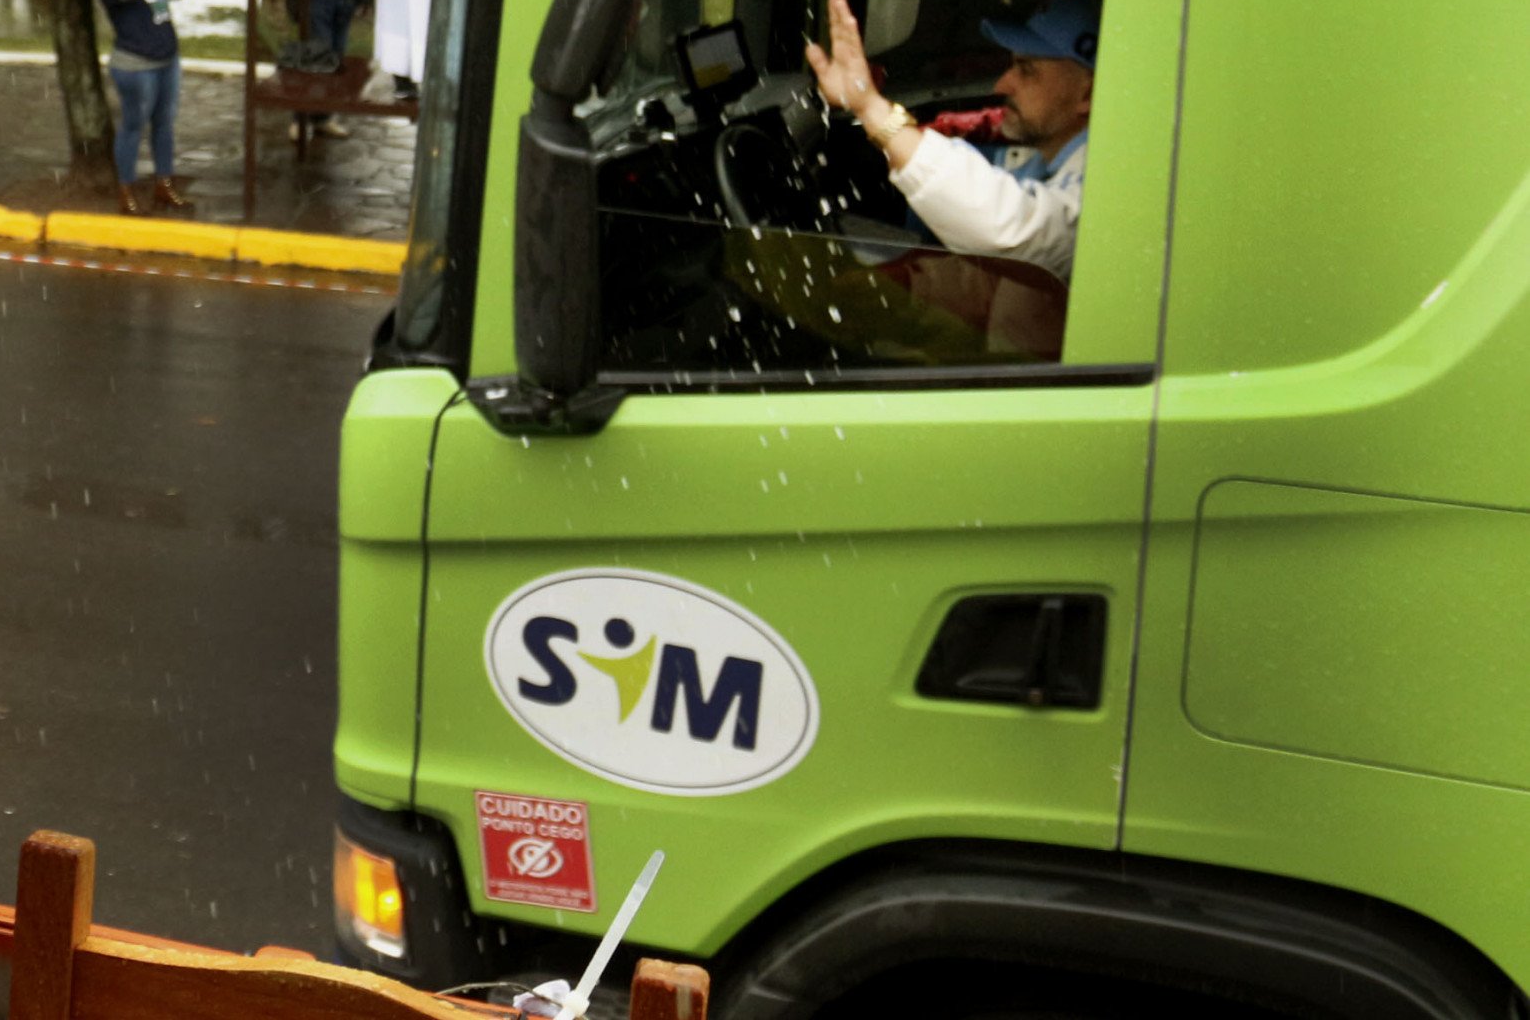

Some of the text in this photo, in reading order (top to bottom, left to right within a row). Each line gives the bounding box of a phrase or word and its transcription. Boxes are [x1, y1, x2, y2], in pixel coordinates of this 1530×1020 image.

[516, 615, 764, 751] SIM
[480, 796, 582, 824] CUIDADO
[482, 817, 583, 840] PONTO CEGO
